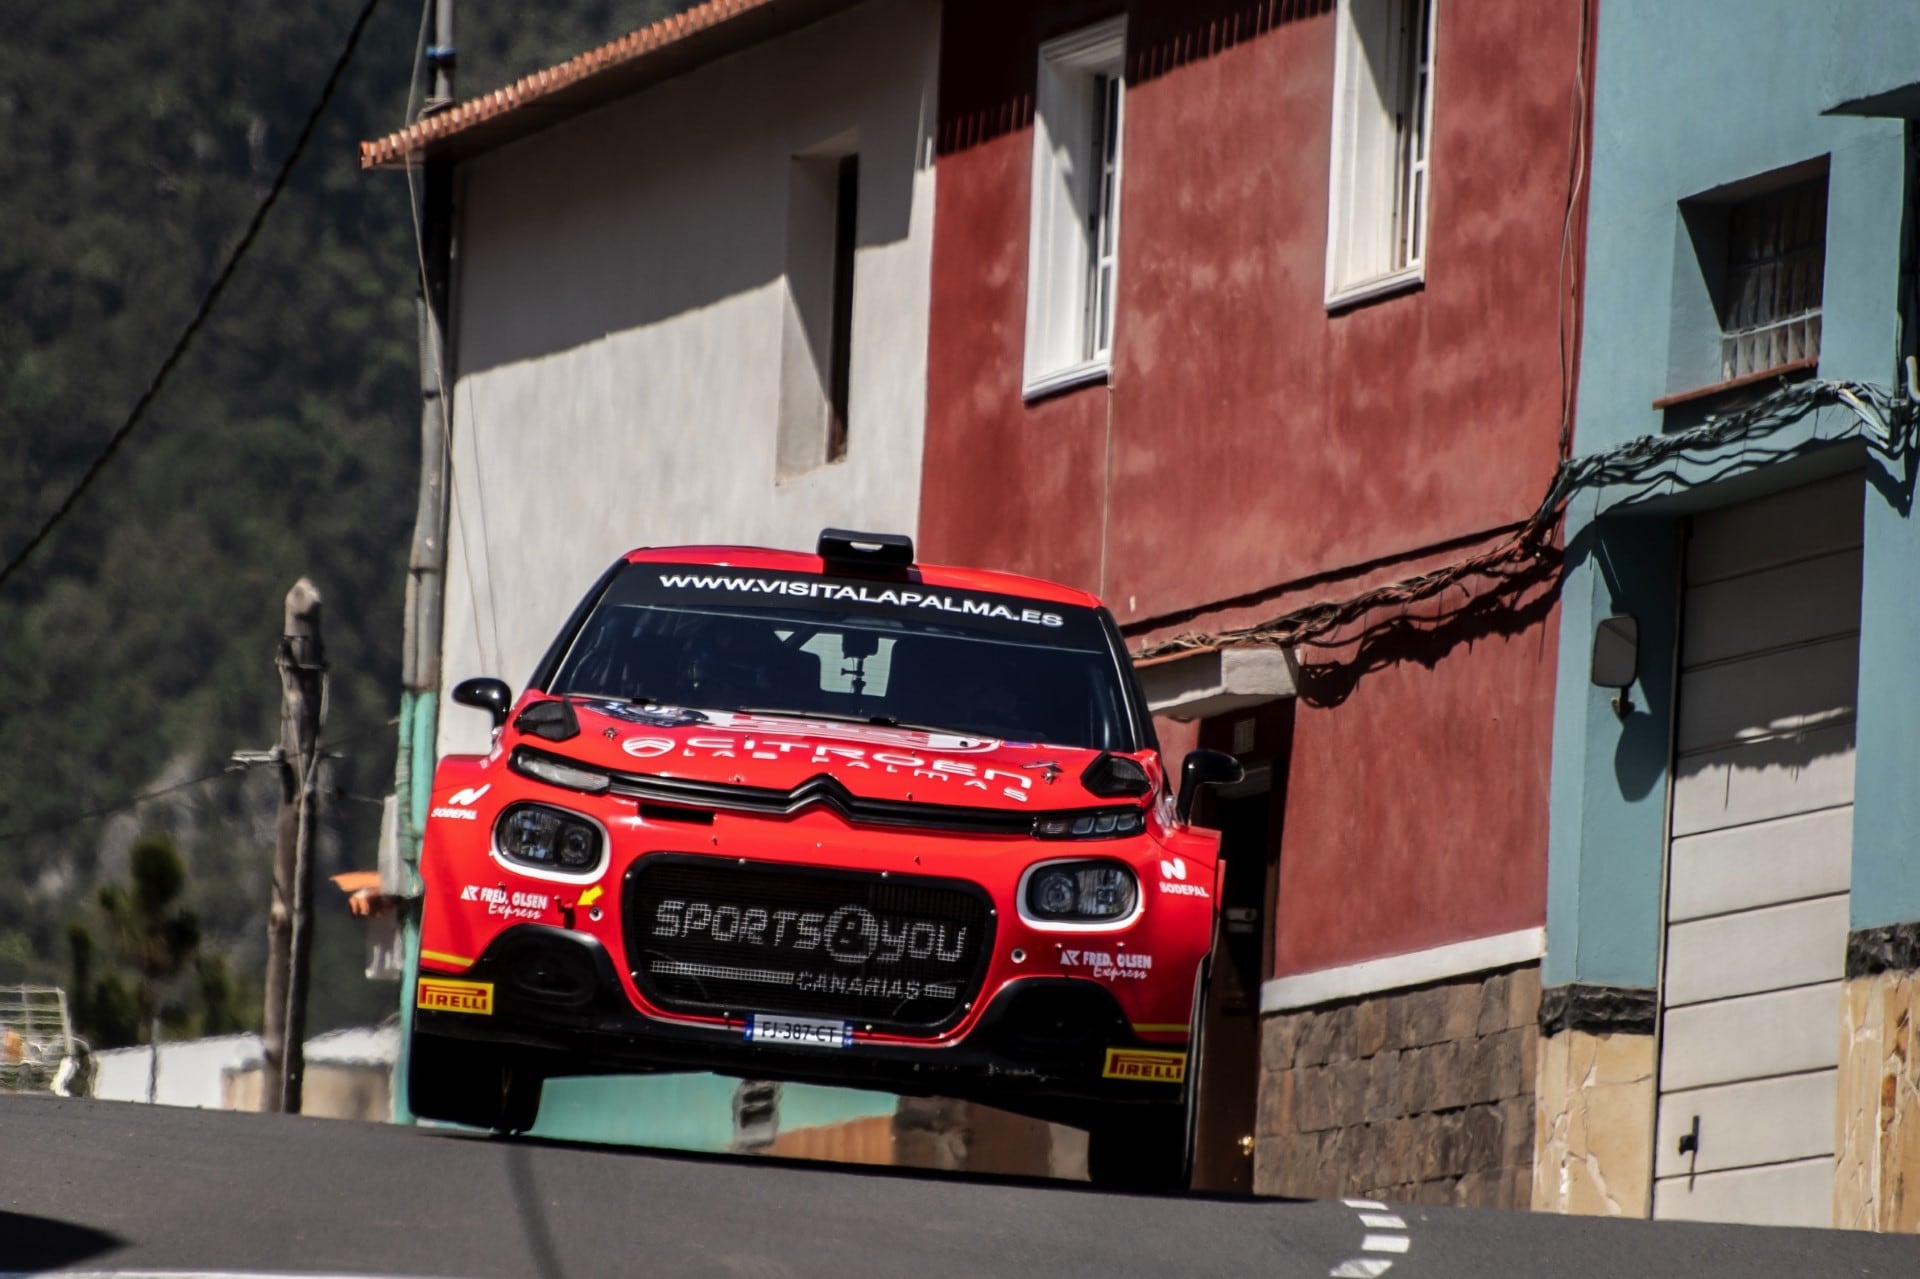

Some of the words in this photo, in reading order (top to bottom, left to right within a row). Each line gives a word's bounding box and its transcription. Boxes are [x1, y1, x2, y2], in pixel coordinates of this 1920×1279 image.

[659, 574, 1064, 628] WWW.VISITALAPALMA.ES
[683, 748, 778, 760] LAS
[811, 756, 1028, 802] PALMAS
[431, 807, 478, 820] SODEPAL
[1159, 881, 1209, 898] SODEPAL
[488, 901, 543, 919] Express
[512, 892, 548, 910] OLSEN
[1083, 951, 1113, 967] FRED.
[1116, 955, 1152, 969] OLSEN
[1093, 966, 1148, 982] Express
[796, 971, 921, 1000] CANARIAS
[419, 983, 488, 1010] PIRELLI
[761, 1022, 837, 1043] FJ-387-CT
[1108, 1054, 1184, 1079] PIRELLI
